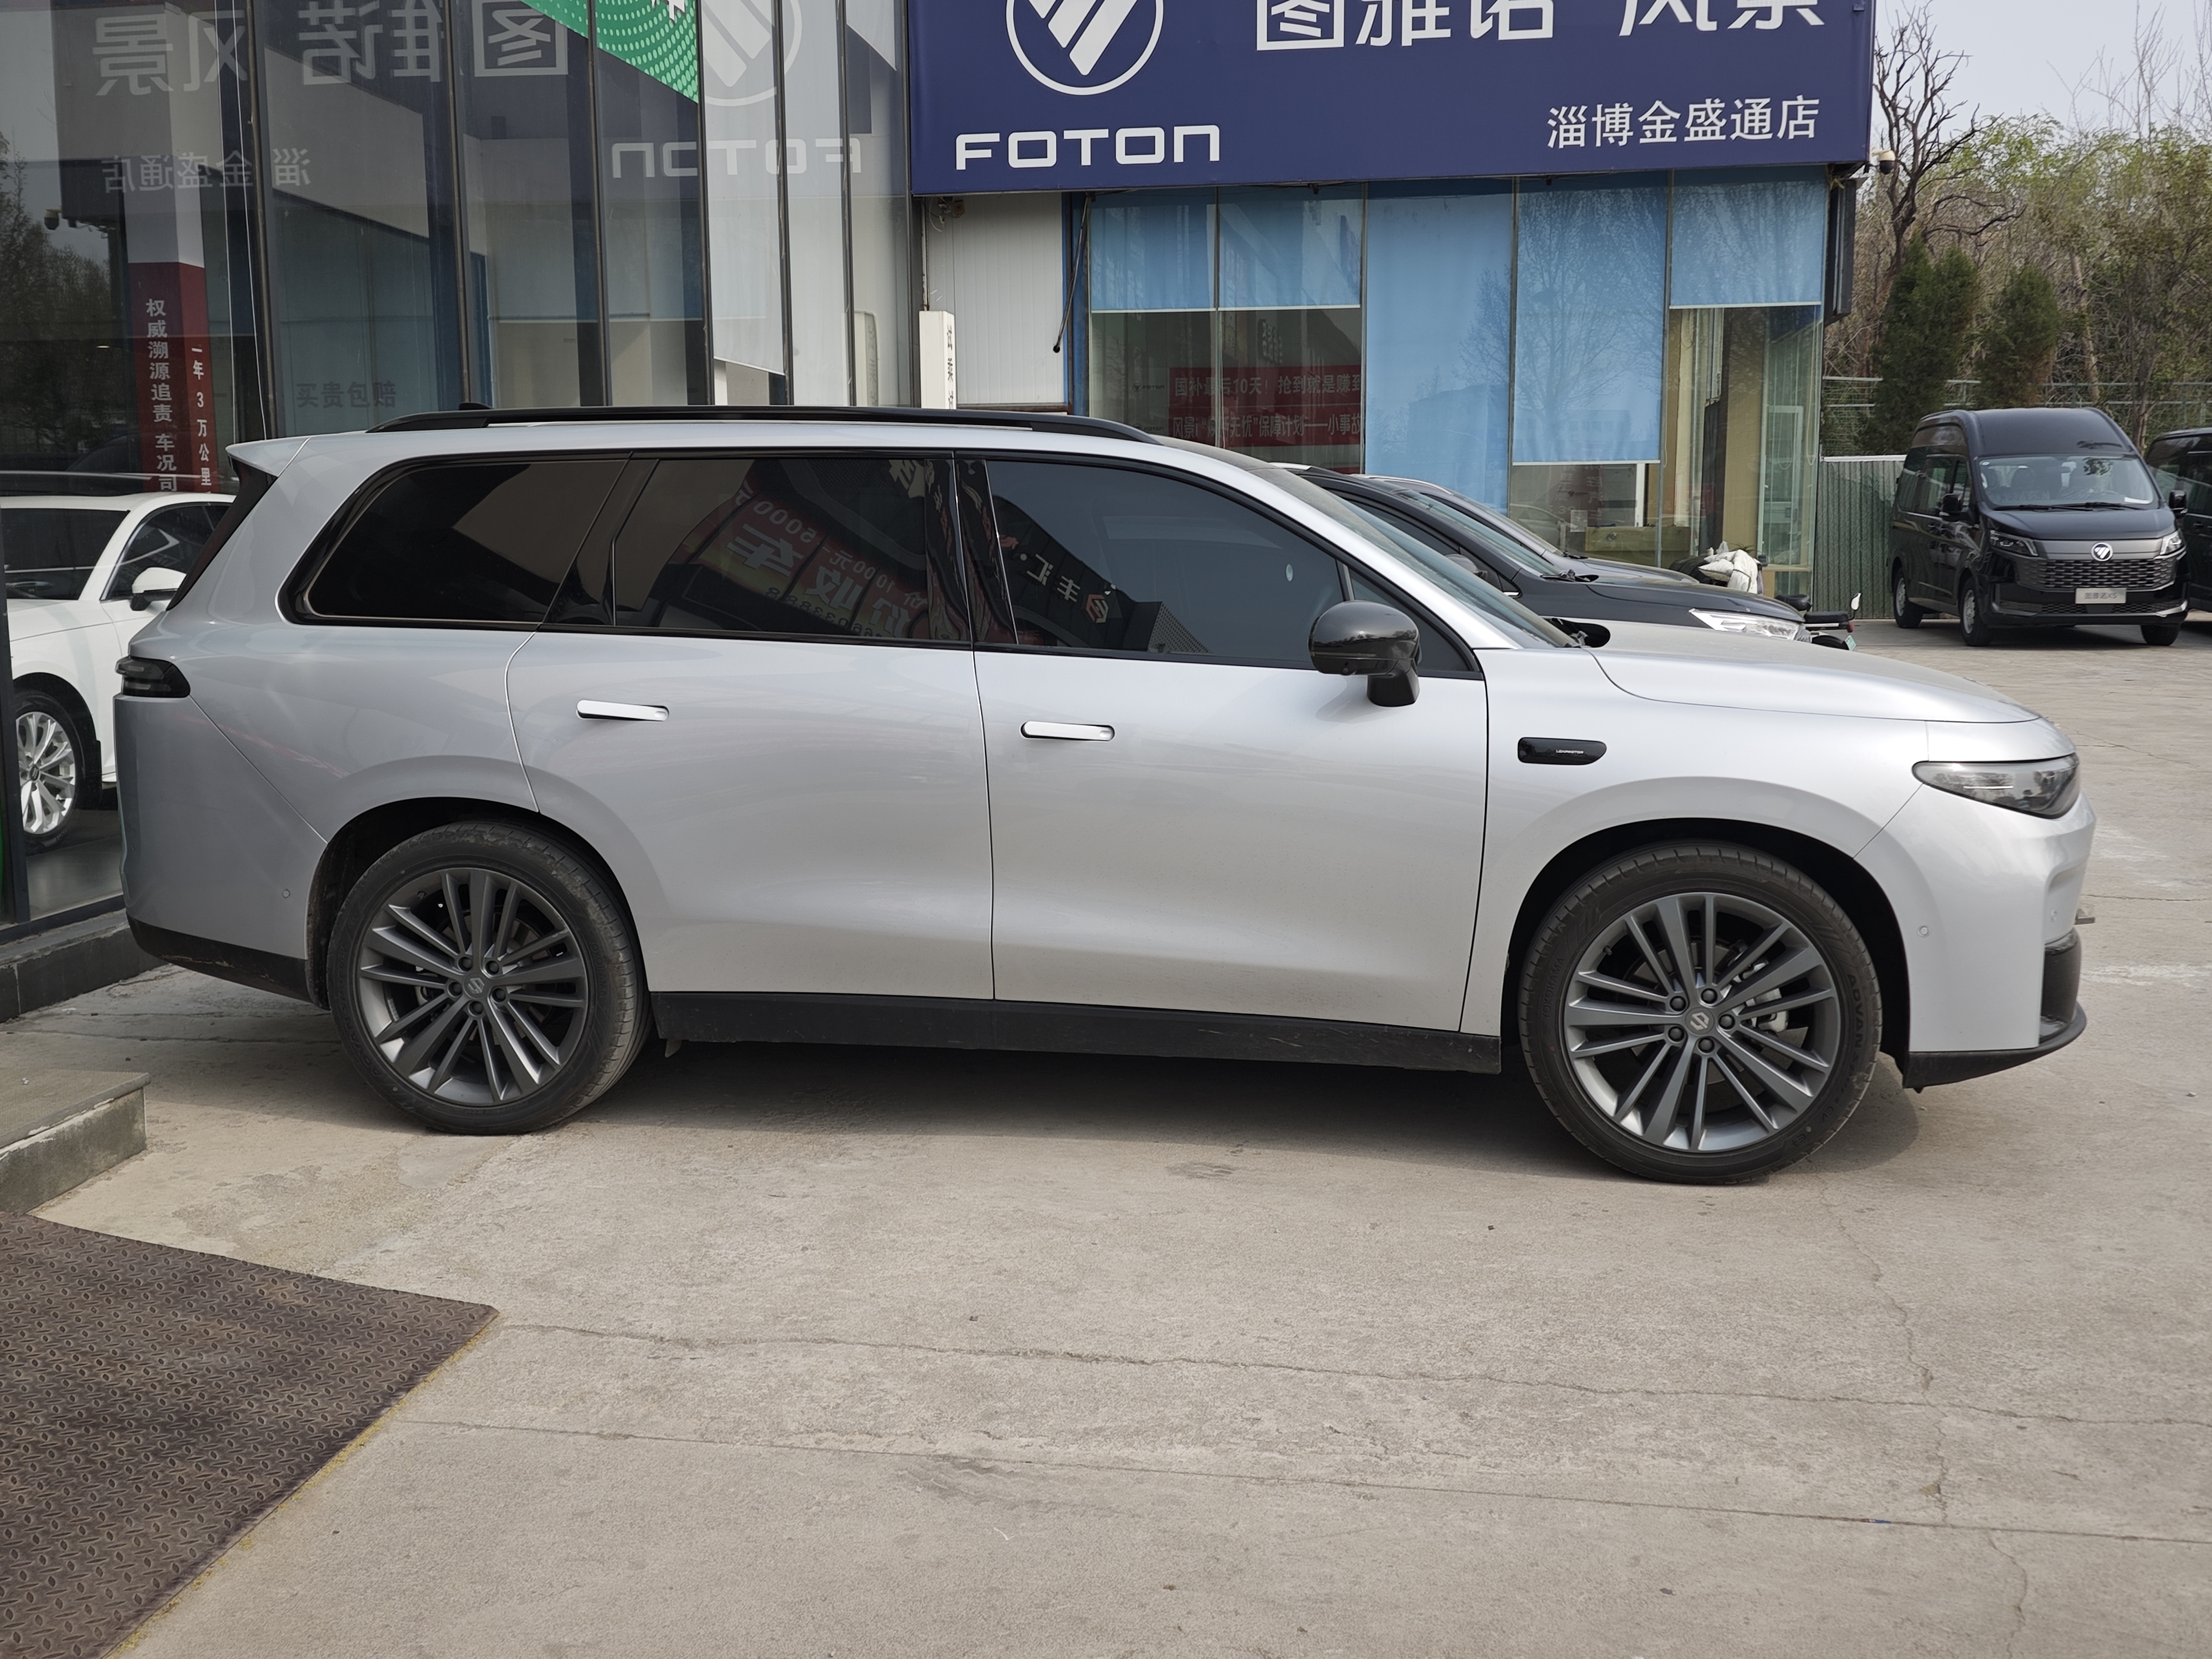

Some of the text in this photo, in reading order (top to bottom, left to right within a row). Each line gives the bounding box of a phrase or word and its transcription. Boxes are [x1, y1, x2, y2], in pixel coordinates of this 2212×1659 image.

[955, 124, 1220, 170] FOTON
[1547, 95, 1820, 150] 淄博金盛通店
[146, 298, 173, 423] 权威溯源追责
[296, 380, 396, 408] 买贵包赔
[1541, 957, 1565, 1019] YOKOHAMA
[1846, 973, 1865, 1049] ADVAN
